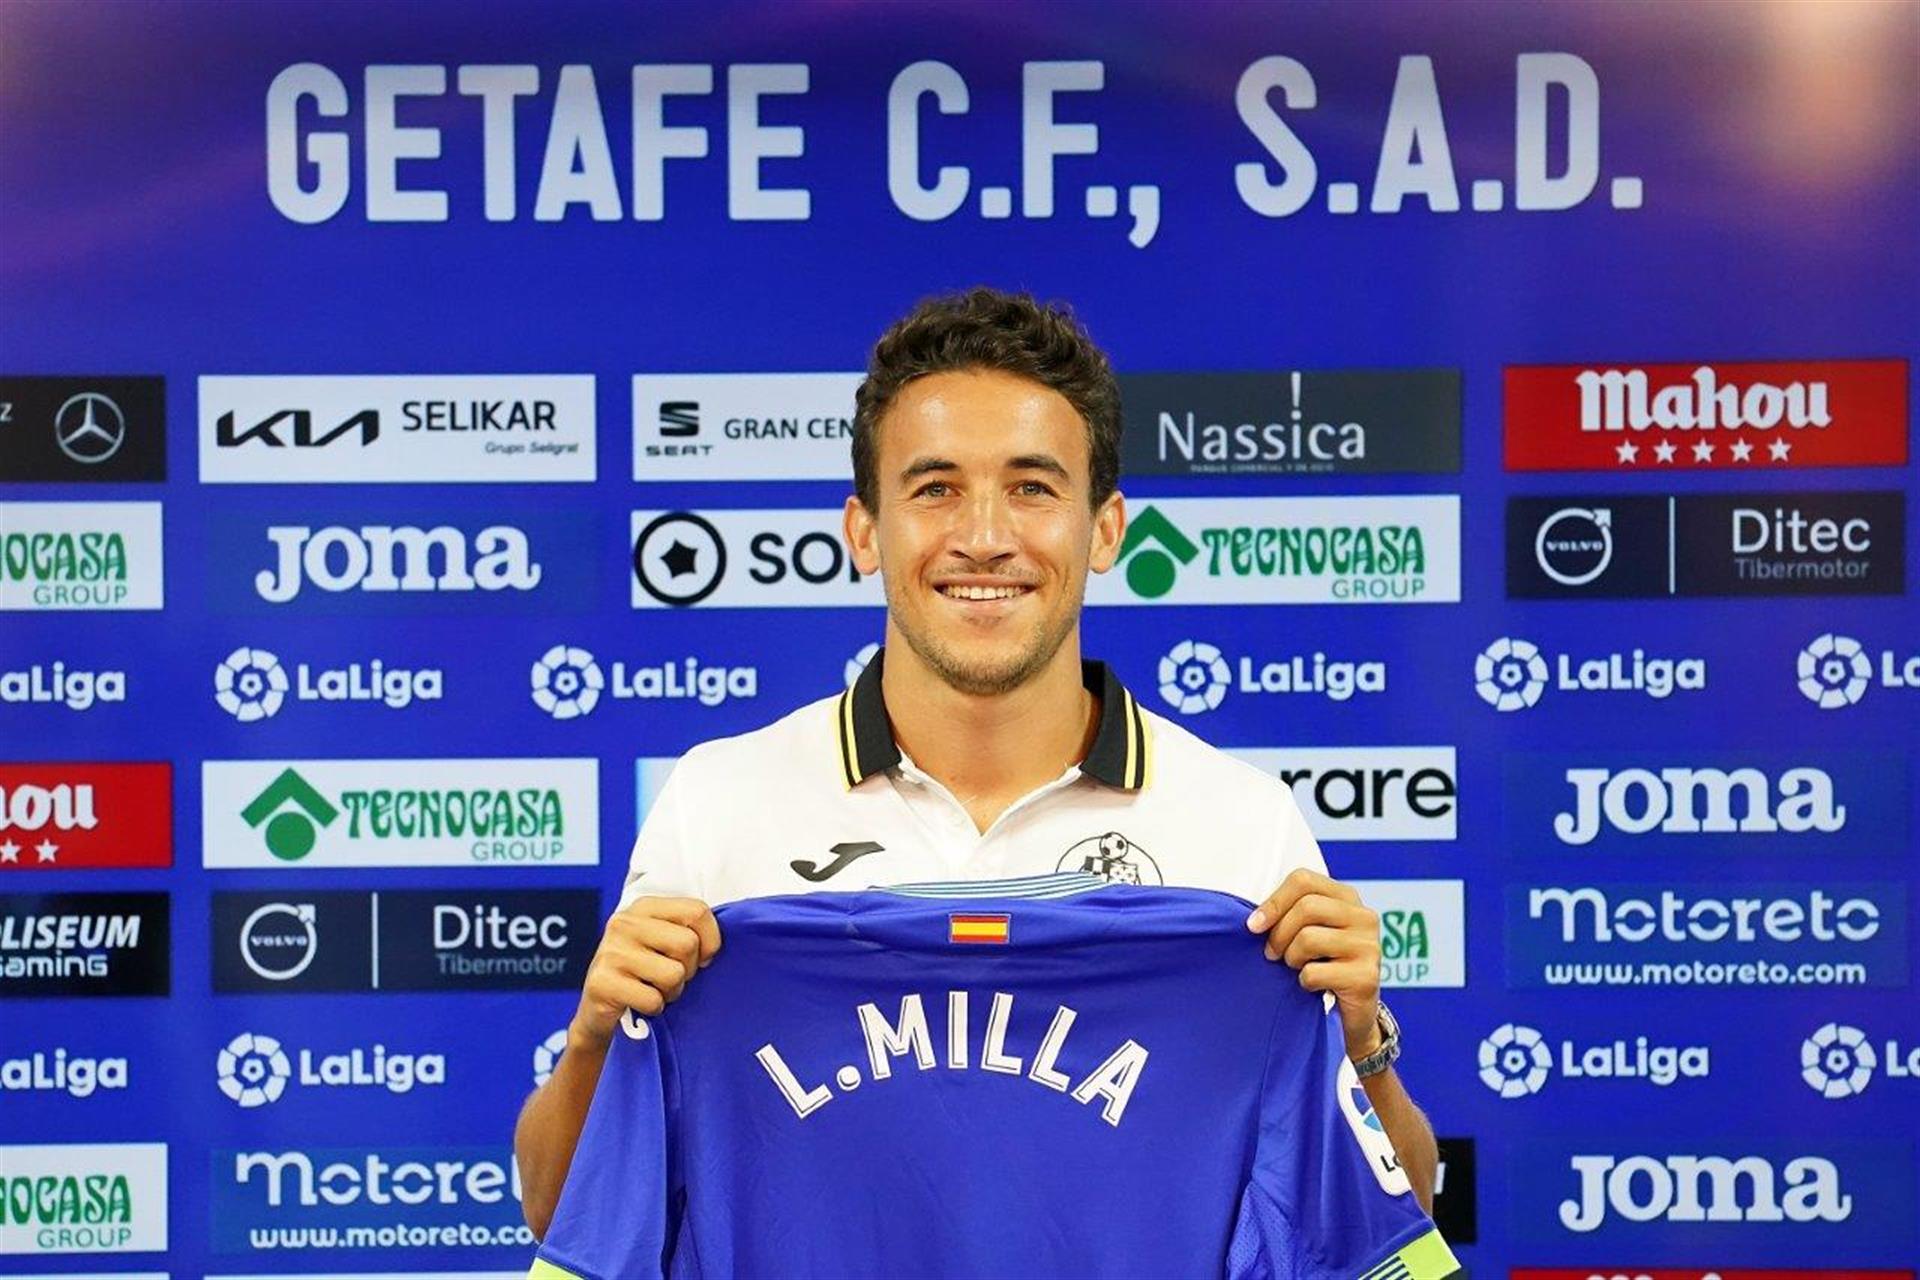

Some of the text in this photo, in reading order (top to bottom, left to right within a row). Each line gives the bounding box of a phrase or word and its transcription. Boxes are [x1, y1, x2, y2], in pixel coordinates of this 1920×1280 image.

[267, 63, 810, 224] GETAFE
[1236, 53, 1642, 217] S.A.D.
[402, 401, 556, 431] SELIKAR
[1159, 371, 1365, 461] Nassica
[1576, 367, 1831, 430] Mahou
[646, 445, 713, 456] SEAT
[724, 418, 798, 439] GRAN
[1201, 525, 1425, 576] TECNOCASA
[1546, 541, 1603, 551] VOLVO
[1732, 508, 1871, 553] Ditec
[0, 533, 127, 581] OCASA
[255, 526, 541, 602] Joma
[749, 532, 861, 584] SO
[1735, 558, 1869, 578] Tibermotor
[34, 585, 127, 605] GROUP
[1332, 579, 1425, 597] GROUP
[298, 660, 442, 707] LaLiga
[613, 658, 756, 706] LaLiga
[1240, 653, 1385, 700] LaLiga
[1559, 649, 1705, 697] LaLiga
[0, 784, 98, 831] ou
[341, 790, 563, 838] TECNOCASA
[1554, 768, 1845, 844] Joma
[471, 841, 564, 861] GROUP
[0, 915, 140, 949] LISEUM
[250, 935, 307, 946] VOLVO
[433, 904, 568, 949] Ditec
[436, 953, 566, 974] Tibermotor
[1545, 960, 1866, 985] www.motoreto.com
[0, 1048, 128, 1097] aLiga
[300, 1045, 444, 1092] LaLiga
[756, 991, 1149, 1127] L.MILLA
[1562, 1037, 1708, 1085] LaLiga
[0, 1175, 131, 1225] OCASA
[1559, 1156, 1852, 1232] Joma
[37, 1228, 132, 1248] GROUP
[250, 1223, 538, 1248] www.motoreto.co
